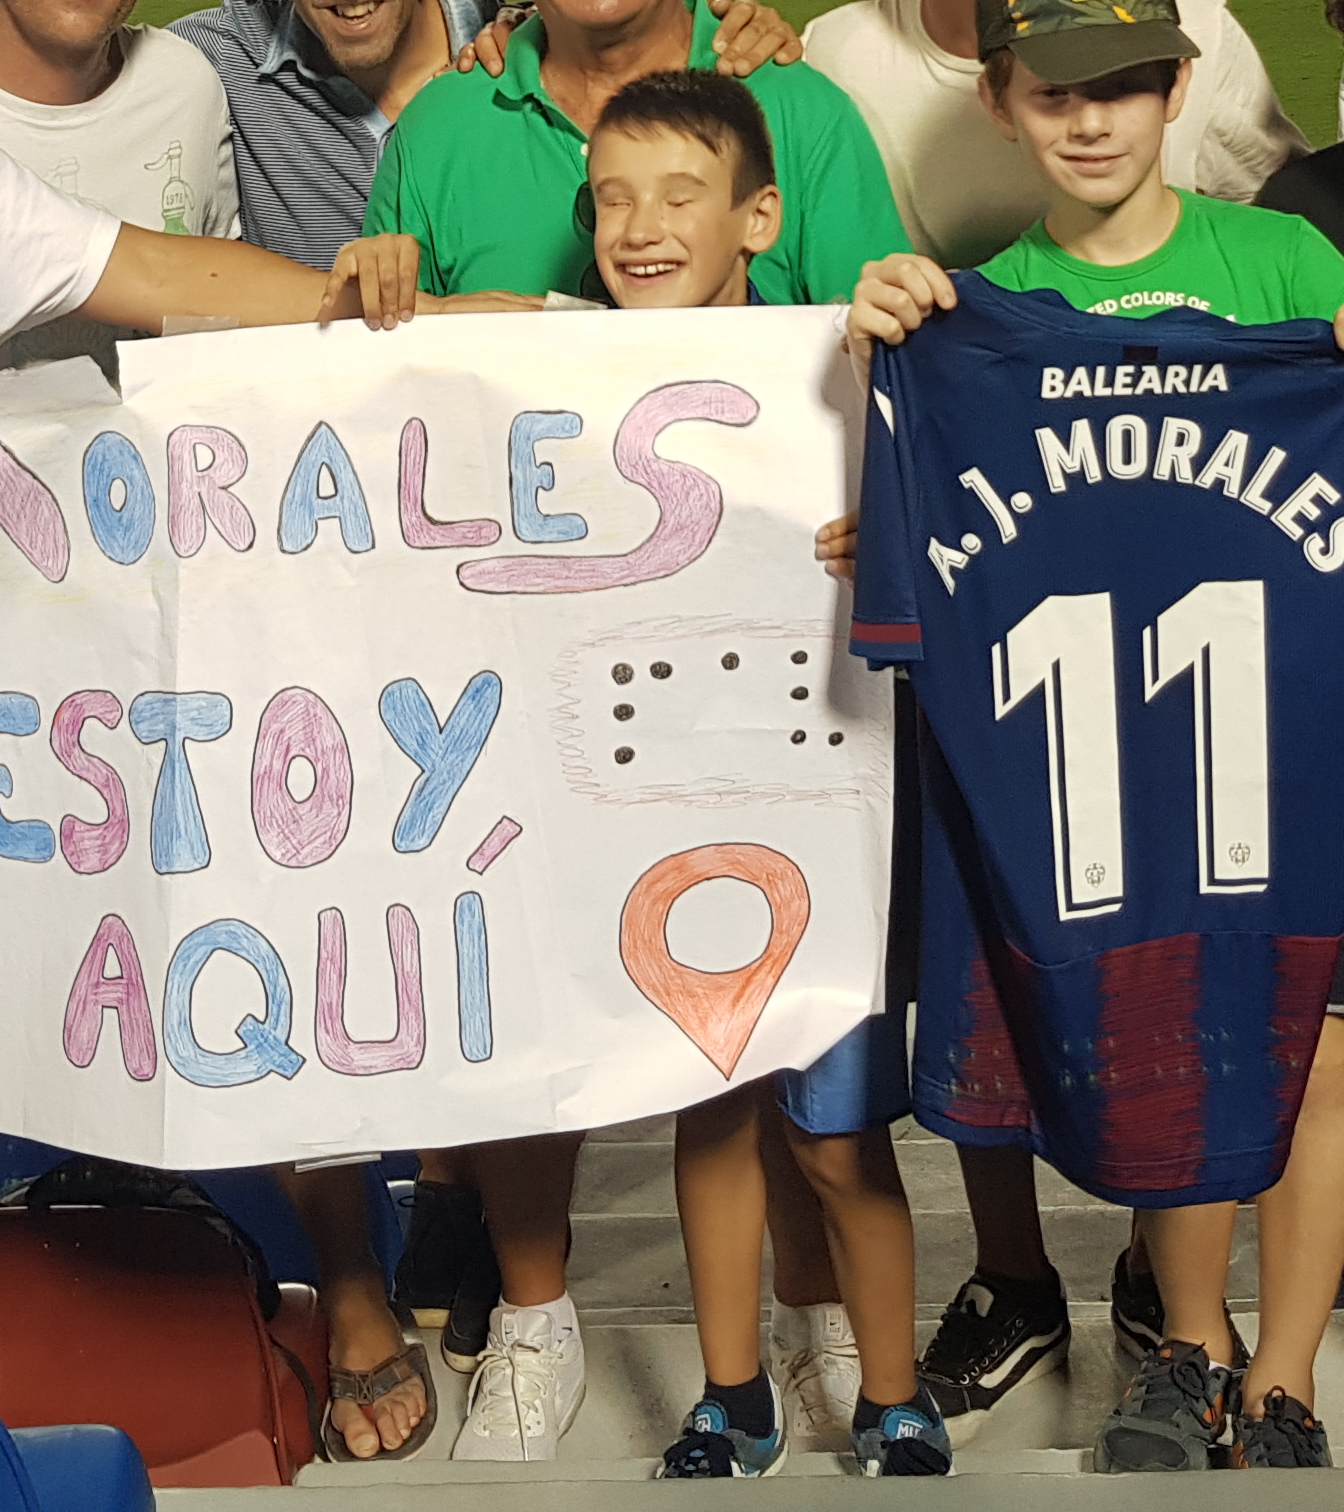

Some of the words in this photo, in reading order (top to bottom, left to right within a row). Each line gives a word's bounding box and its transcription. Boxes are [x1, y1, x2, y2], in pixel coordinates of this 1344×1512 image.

[1119, 291, 1186, 309] COLORS
[991, 579, 1271, 921] 11
[62, 814, 524, 1088] AQUÍ
